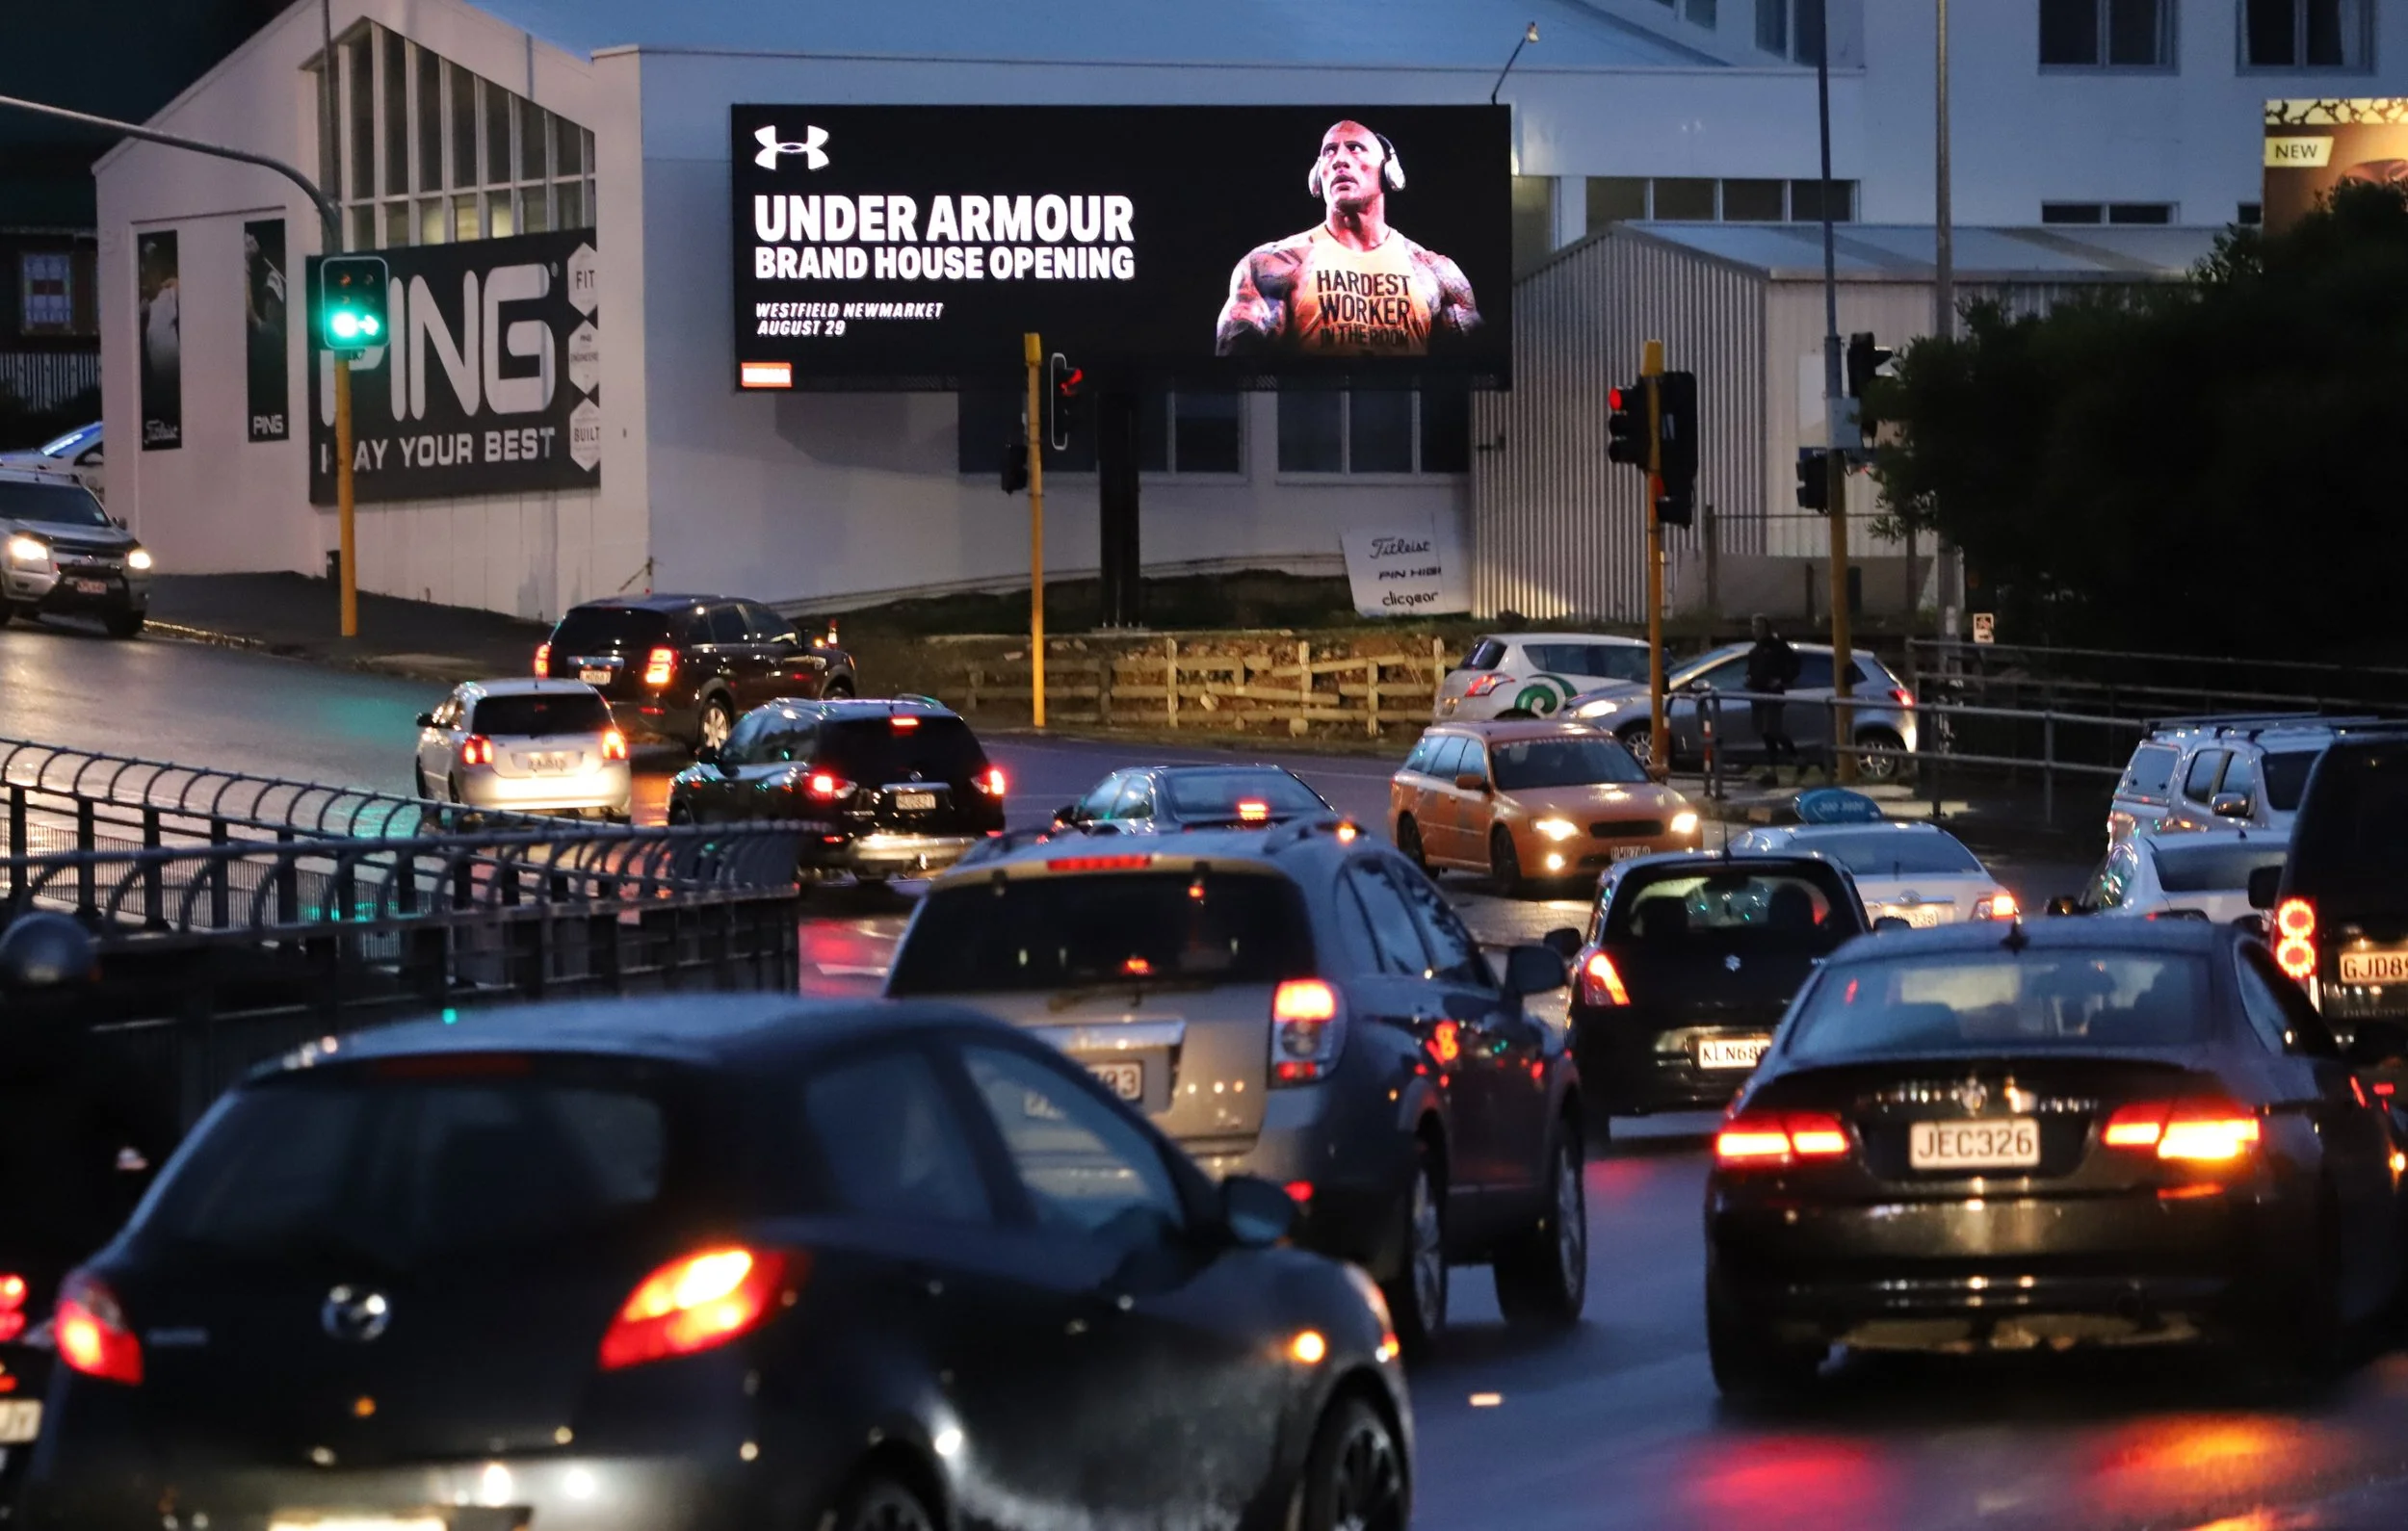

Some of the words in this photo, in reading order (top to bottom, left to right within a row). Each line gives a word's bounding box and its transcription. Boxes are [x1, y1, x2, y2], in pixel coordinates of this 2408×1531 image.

[2275, 143, 2317, 159] NEW
[754, 195, 918, 243] UNDER
[926, 194, 1135, 243] ARMOUR
[754, 247, 868, 279] BRAND
[874, 247, 984, 279] HOUSE
[989, 247, 1135, 279] OPENING
[575, 270, 595, 289] FIT
[1316, 270, 1411, 298] HARDEST
[755, 302, 840, 319] WESTFIELD
[843, 302, 944, 319] NEWMARKET
[1319, 295, 1412, 329] WORKER
[756, 320, 822, 335] AUGUST
[824, 320, 847, 335] 29
[399, 433, 473, 469] YOUR
[484, 428, 556, 462] BEST
[1369, 535, 1430, 559] Titleist
[1381, 590, 1439, 607] clicgear
[2343, 956, 2408, 979] GJD8
[1918, 1128, 2032, 1158] JEC326
